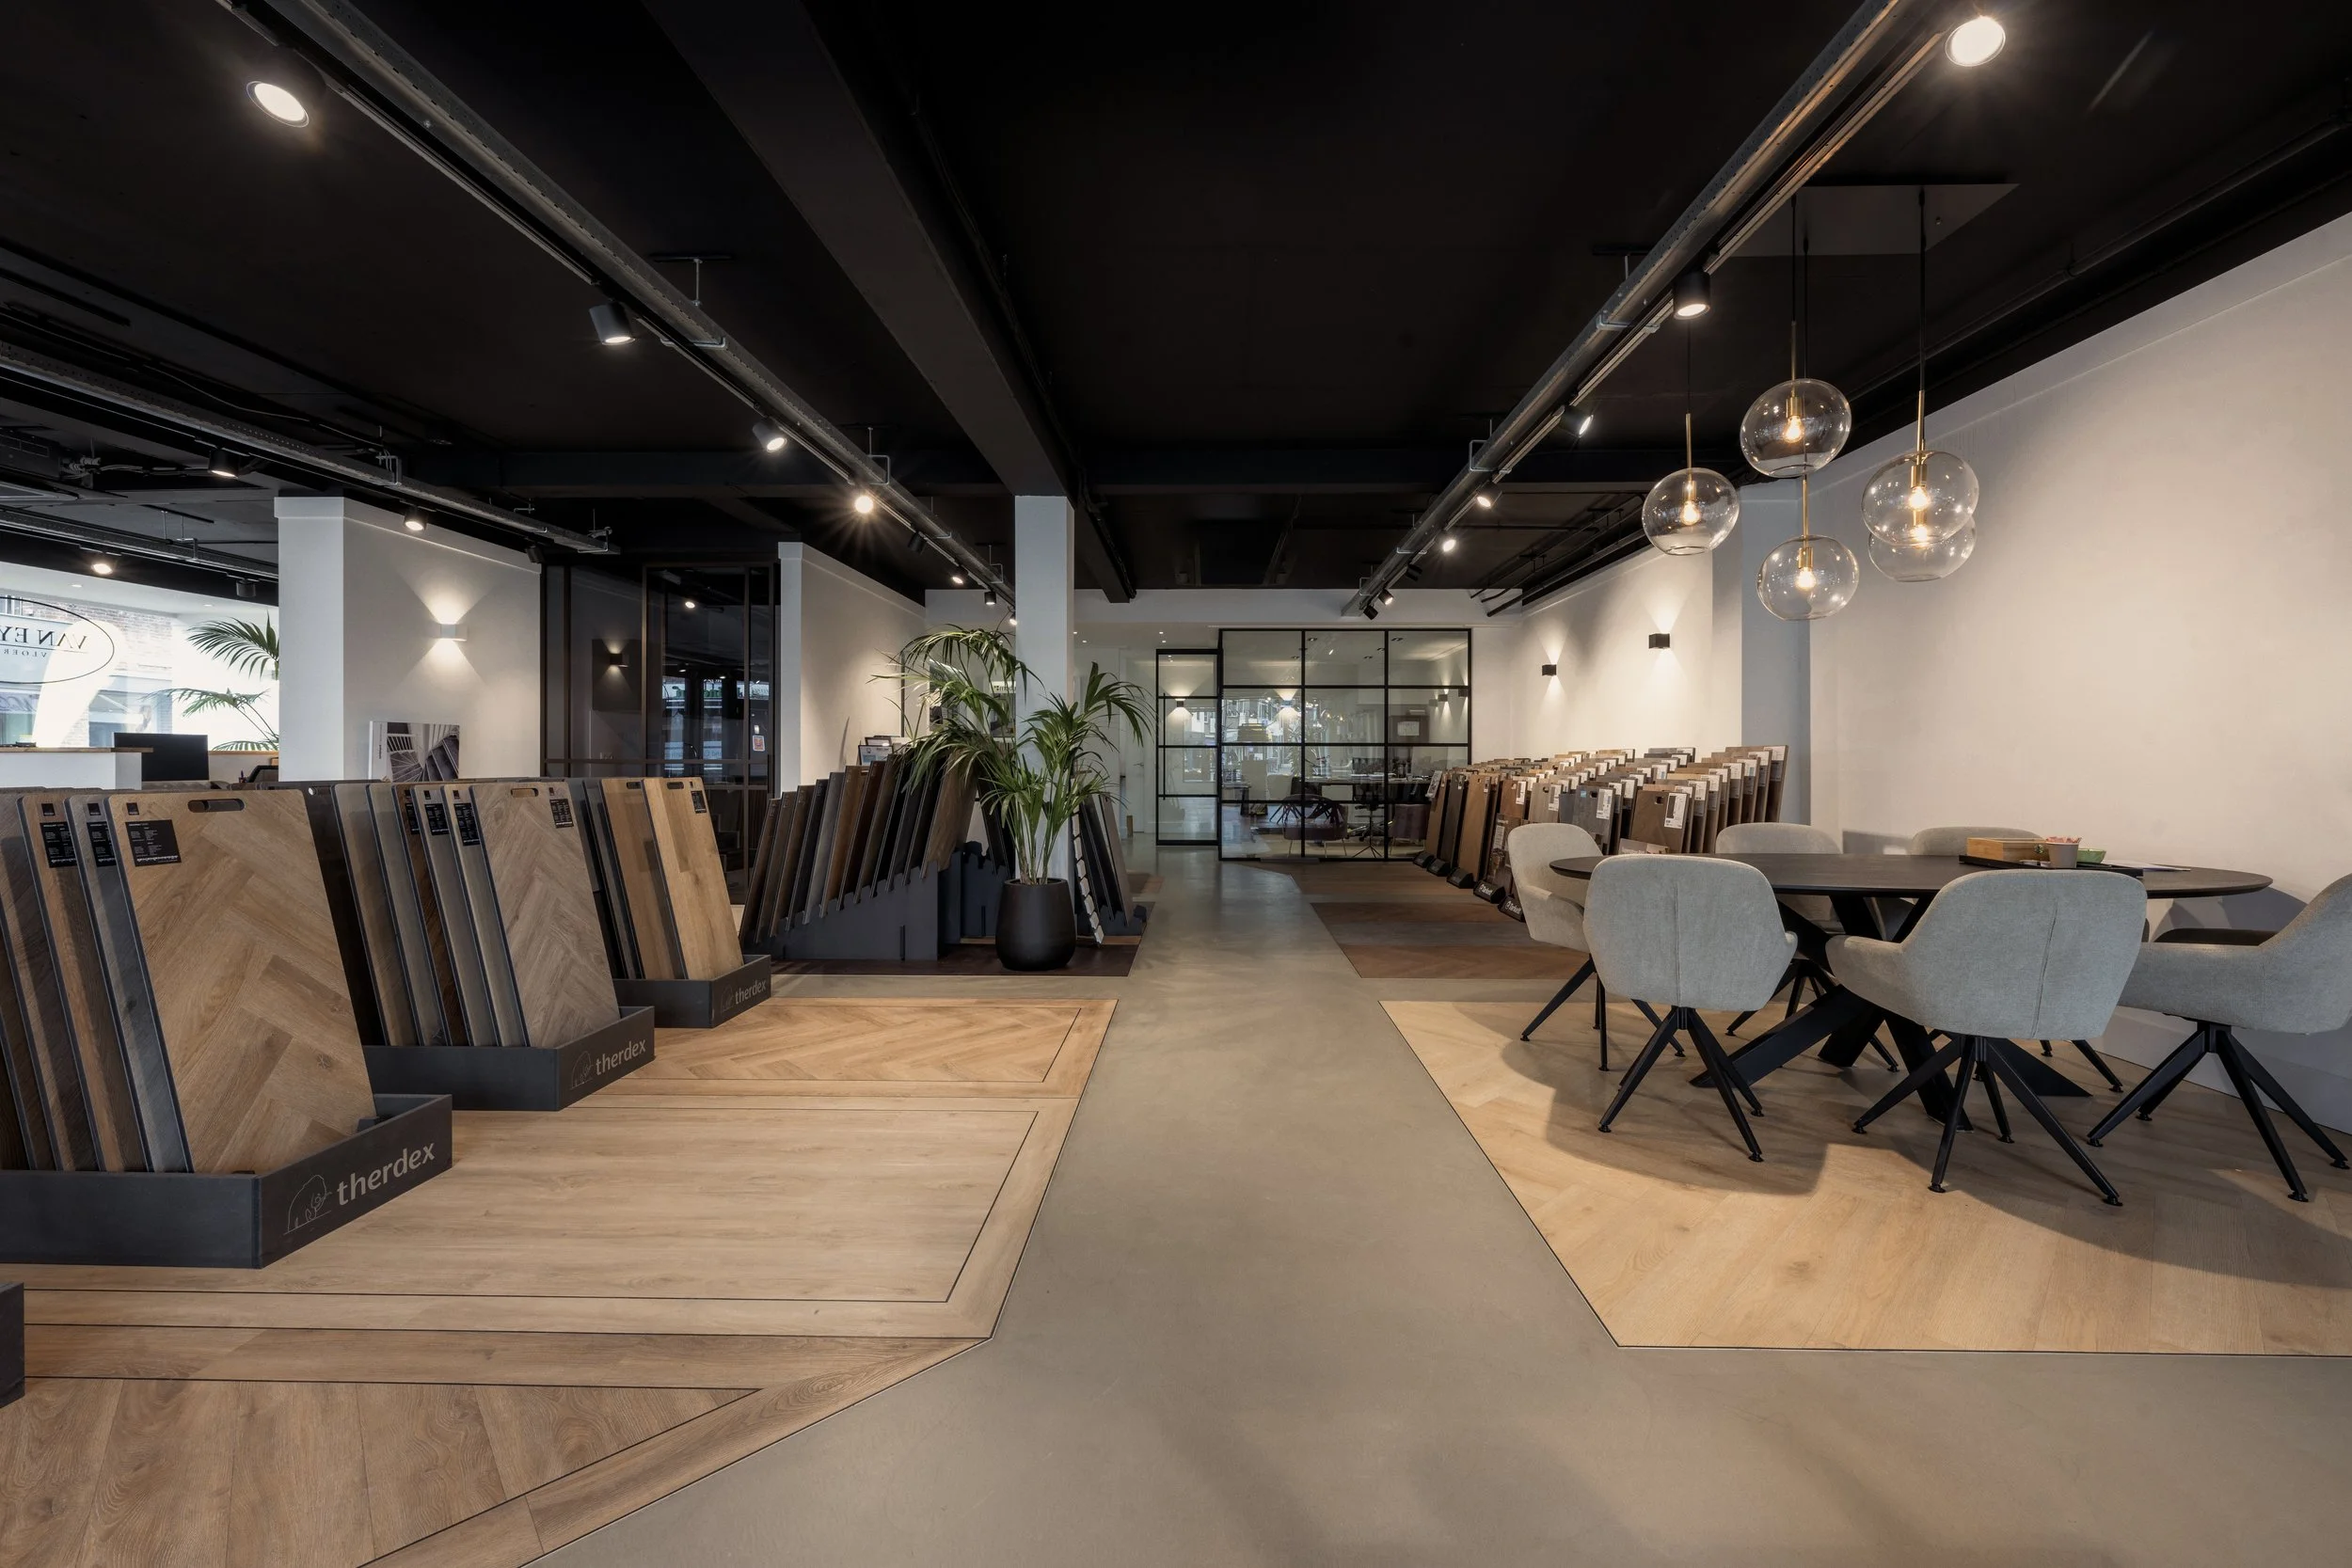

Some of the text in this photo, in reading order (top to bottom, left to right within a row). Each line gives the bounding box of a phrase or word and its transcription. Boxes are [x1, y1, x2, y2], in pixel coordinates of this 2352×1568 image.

[735, 979, 767, 1005] therdex
[596, 1038, 646, 1076] therdex
[337, 1143, 436, 1206] therdex
